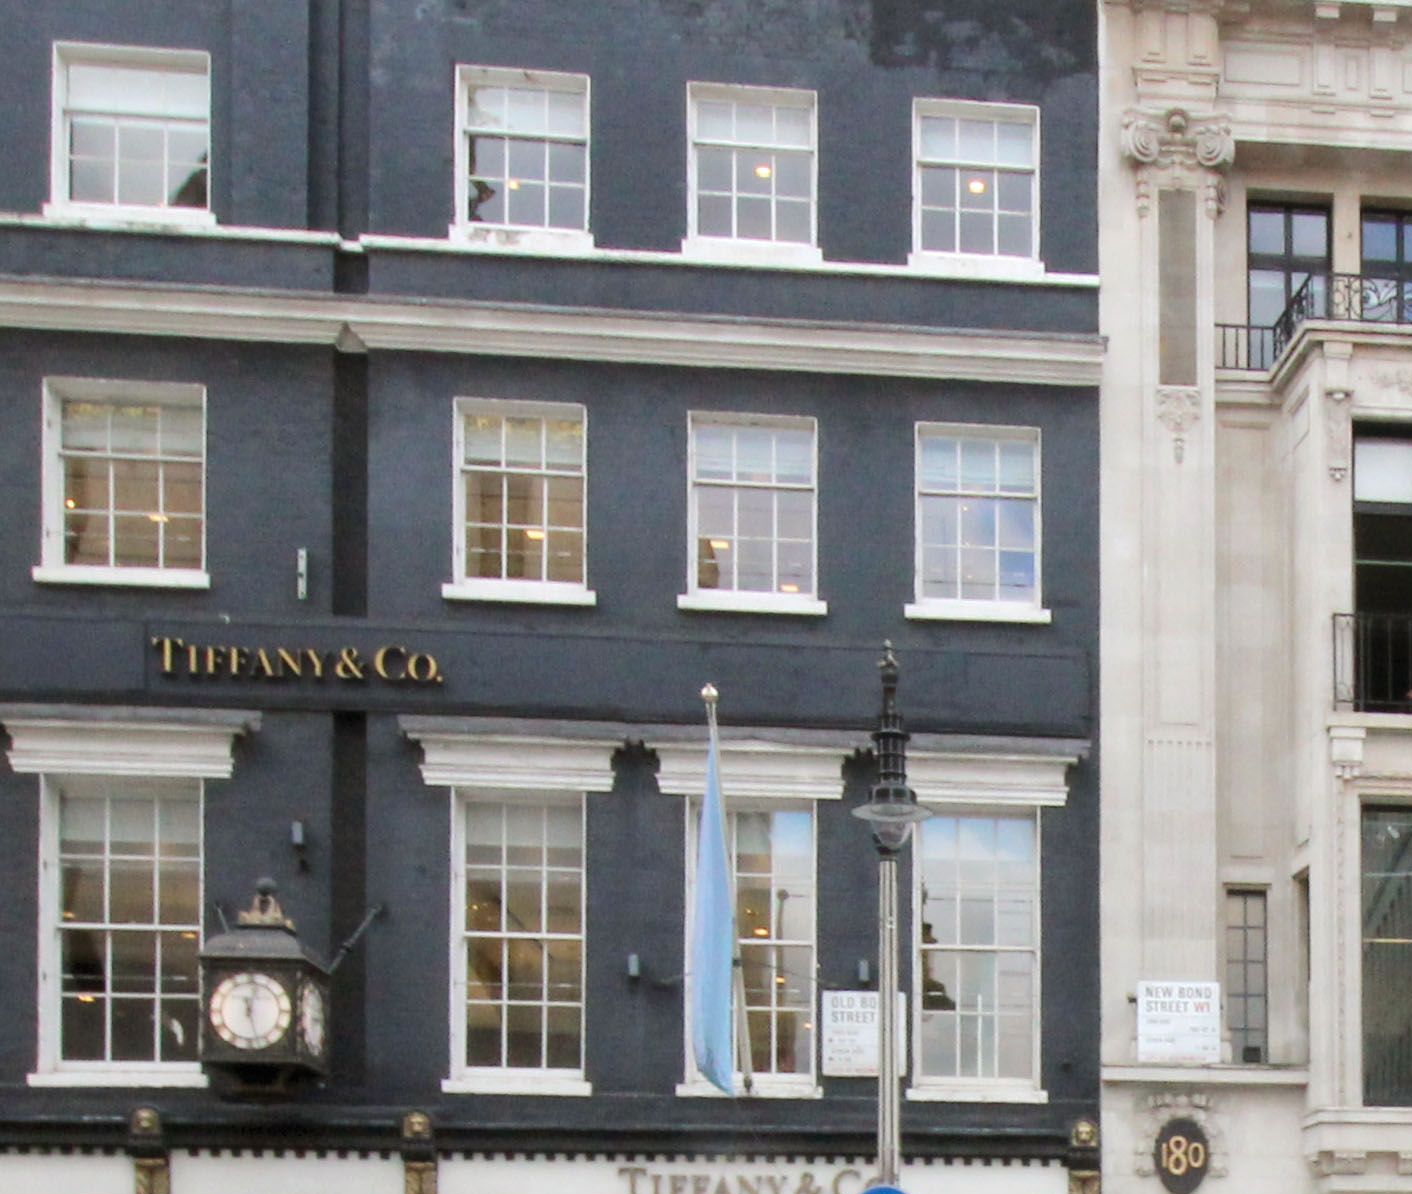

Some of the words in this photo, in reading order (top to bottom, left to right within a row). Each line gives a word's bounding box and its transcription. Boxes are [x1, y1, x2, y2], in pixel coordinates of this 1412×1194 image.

[1145, 986, 1173, 999] NEW
[1178, 986, 1212, 999] BOND
[831, 996, 855, 1009] OLD
[1145, 1001, 1189, 1013] STREET
[1193, 1001, 1211, 1014] W1
[831, 1010, 876, 1023] STREET
[1161, 1135, 1205, 1175] 180
